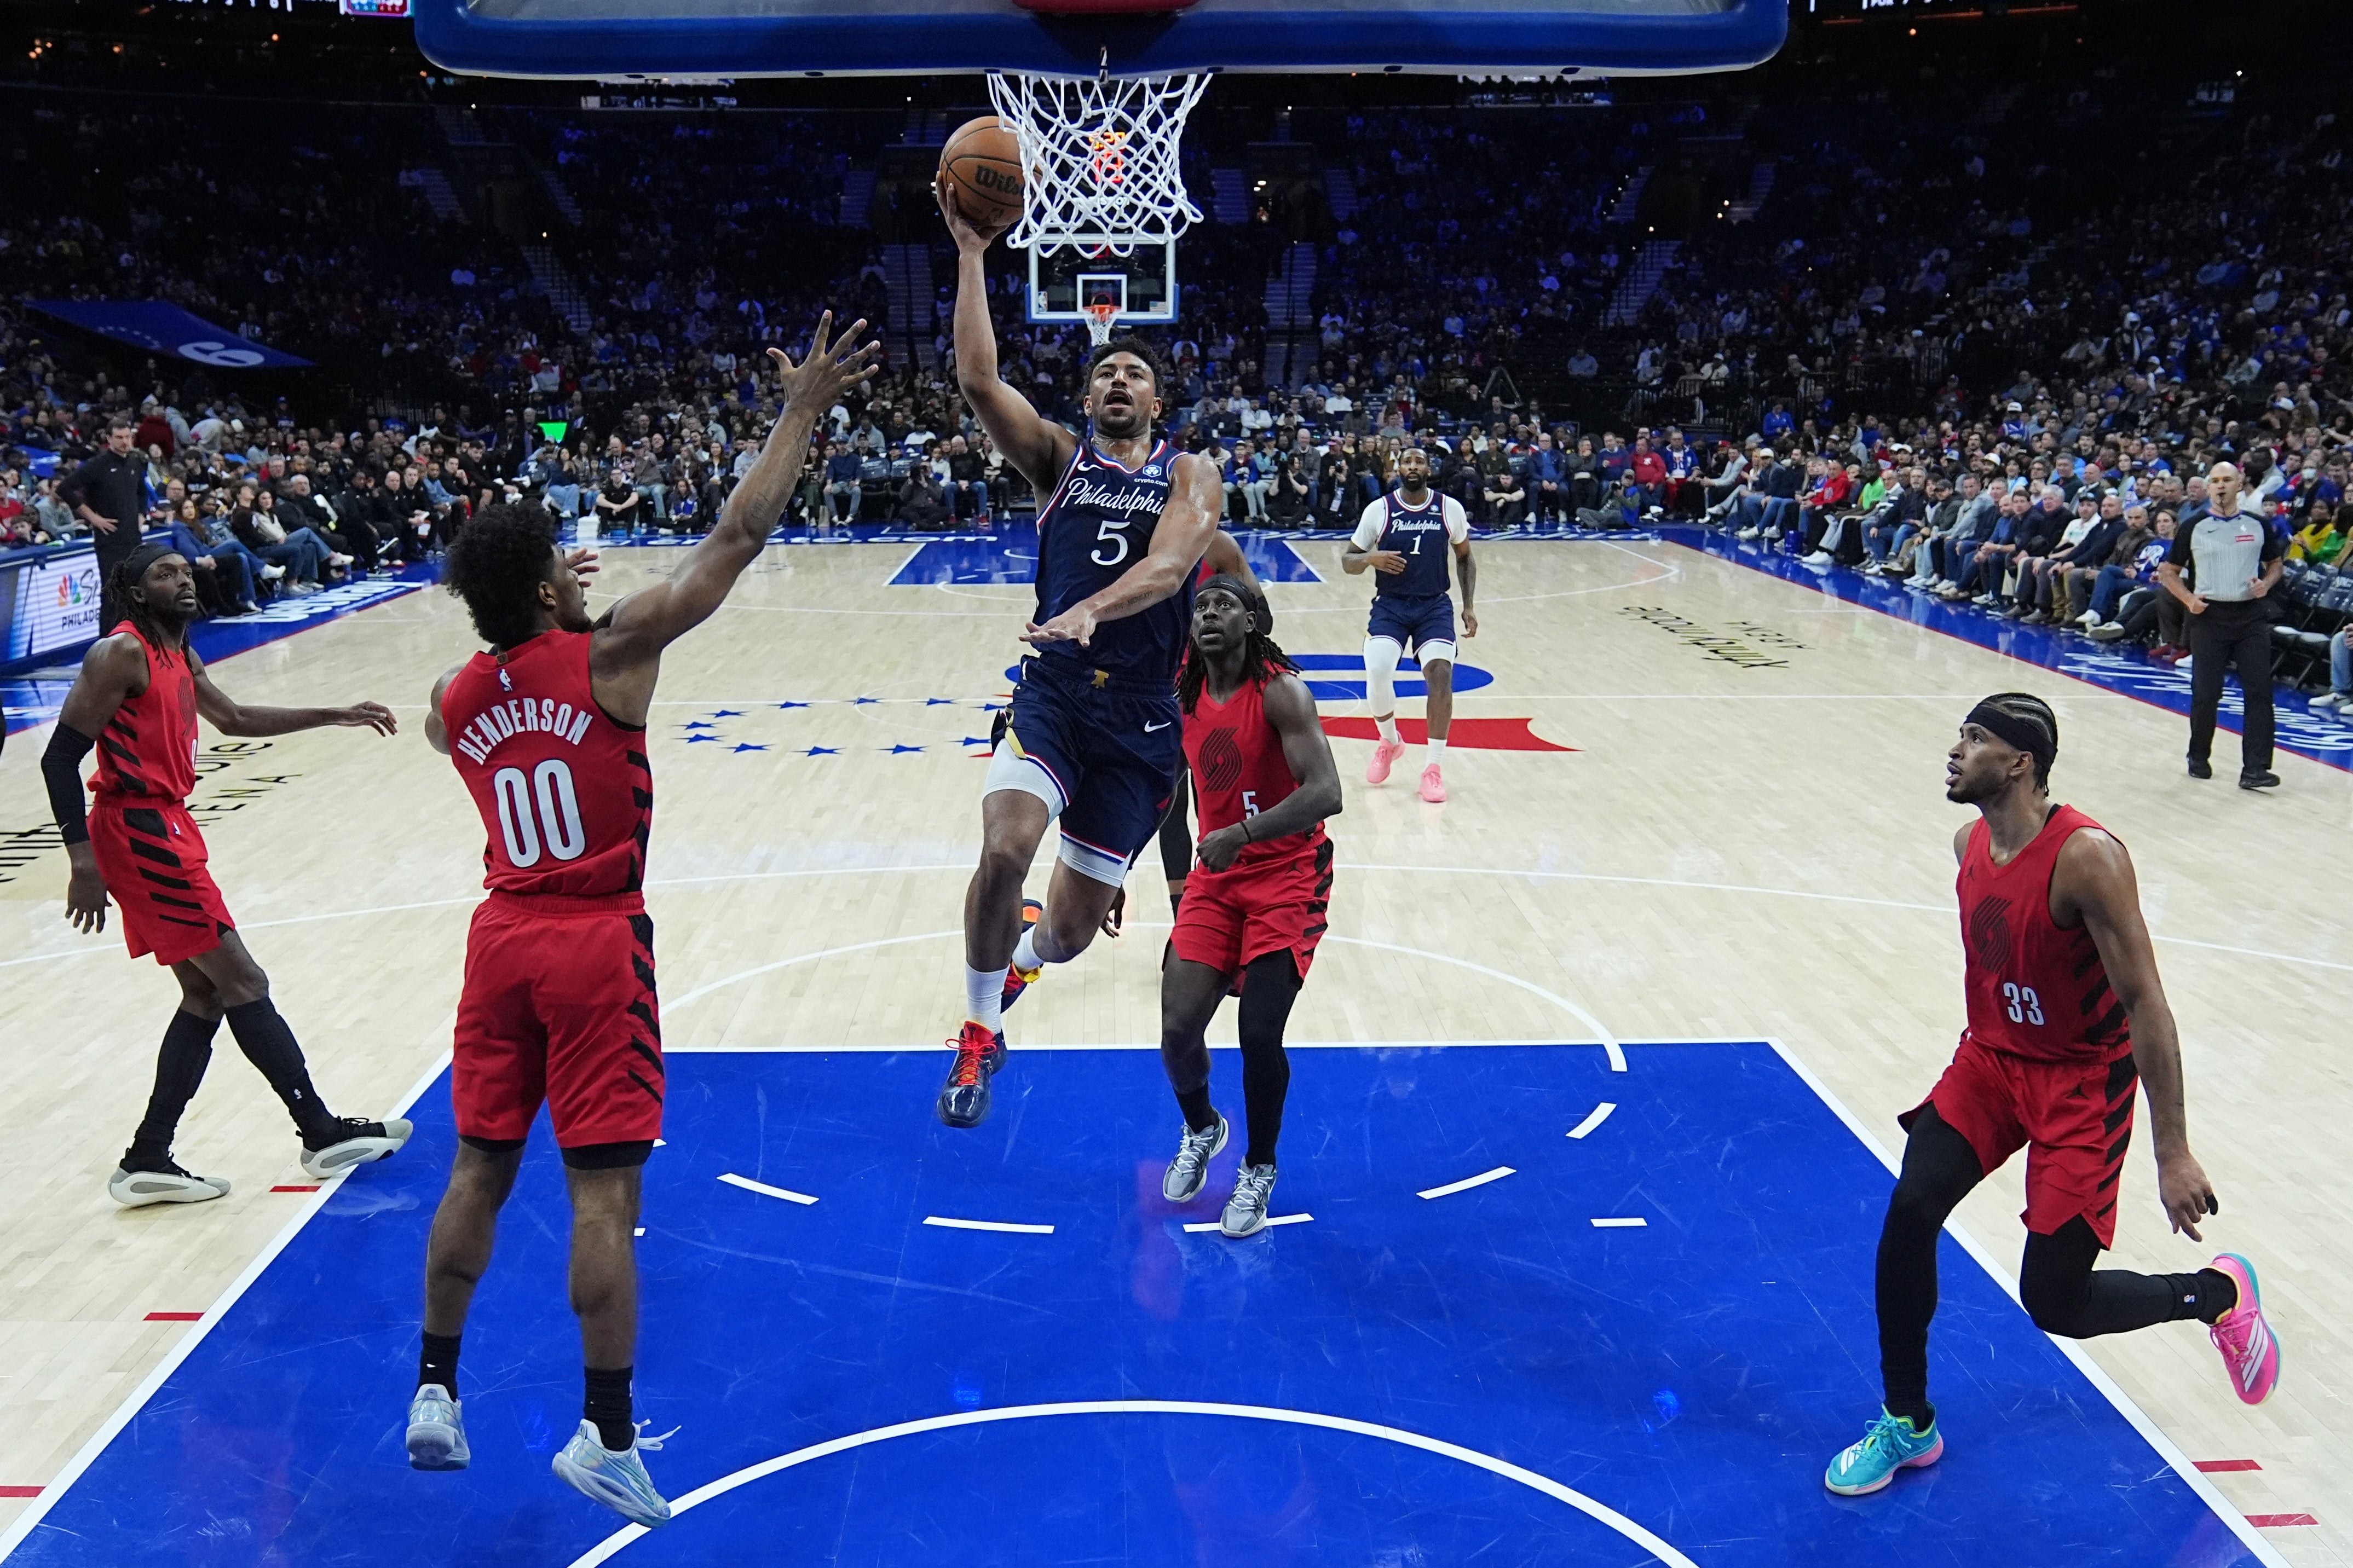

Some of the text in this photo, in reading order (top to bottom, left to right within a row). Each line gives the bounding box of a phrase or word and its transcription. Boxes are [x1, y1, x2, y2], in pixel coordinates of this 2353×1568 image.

[1134, 477, 1168, 487] crypto.com
[1090, 519, 1131, 566] 5
[1390, 519, 1442, 534] Philadelphia
[1409, 534, 1421, 555] 1
[457, 697, 593, 766] HENDERSON
[493, 759, 587, 869] 00
[1242, 790, 1260, 820] 5
[2003, 981, 2045, 1026] 33
